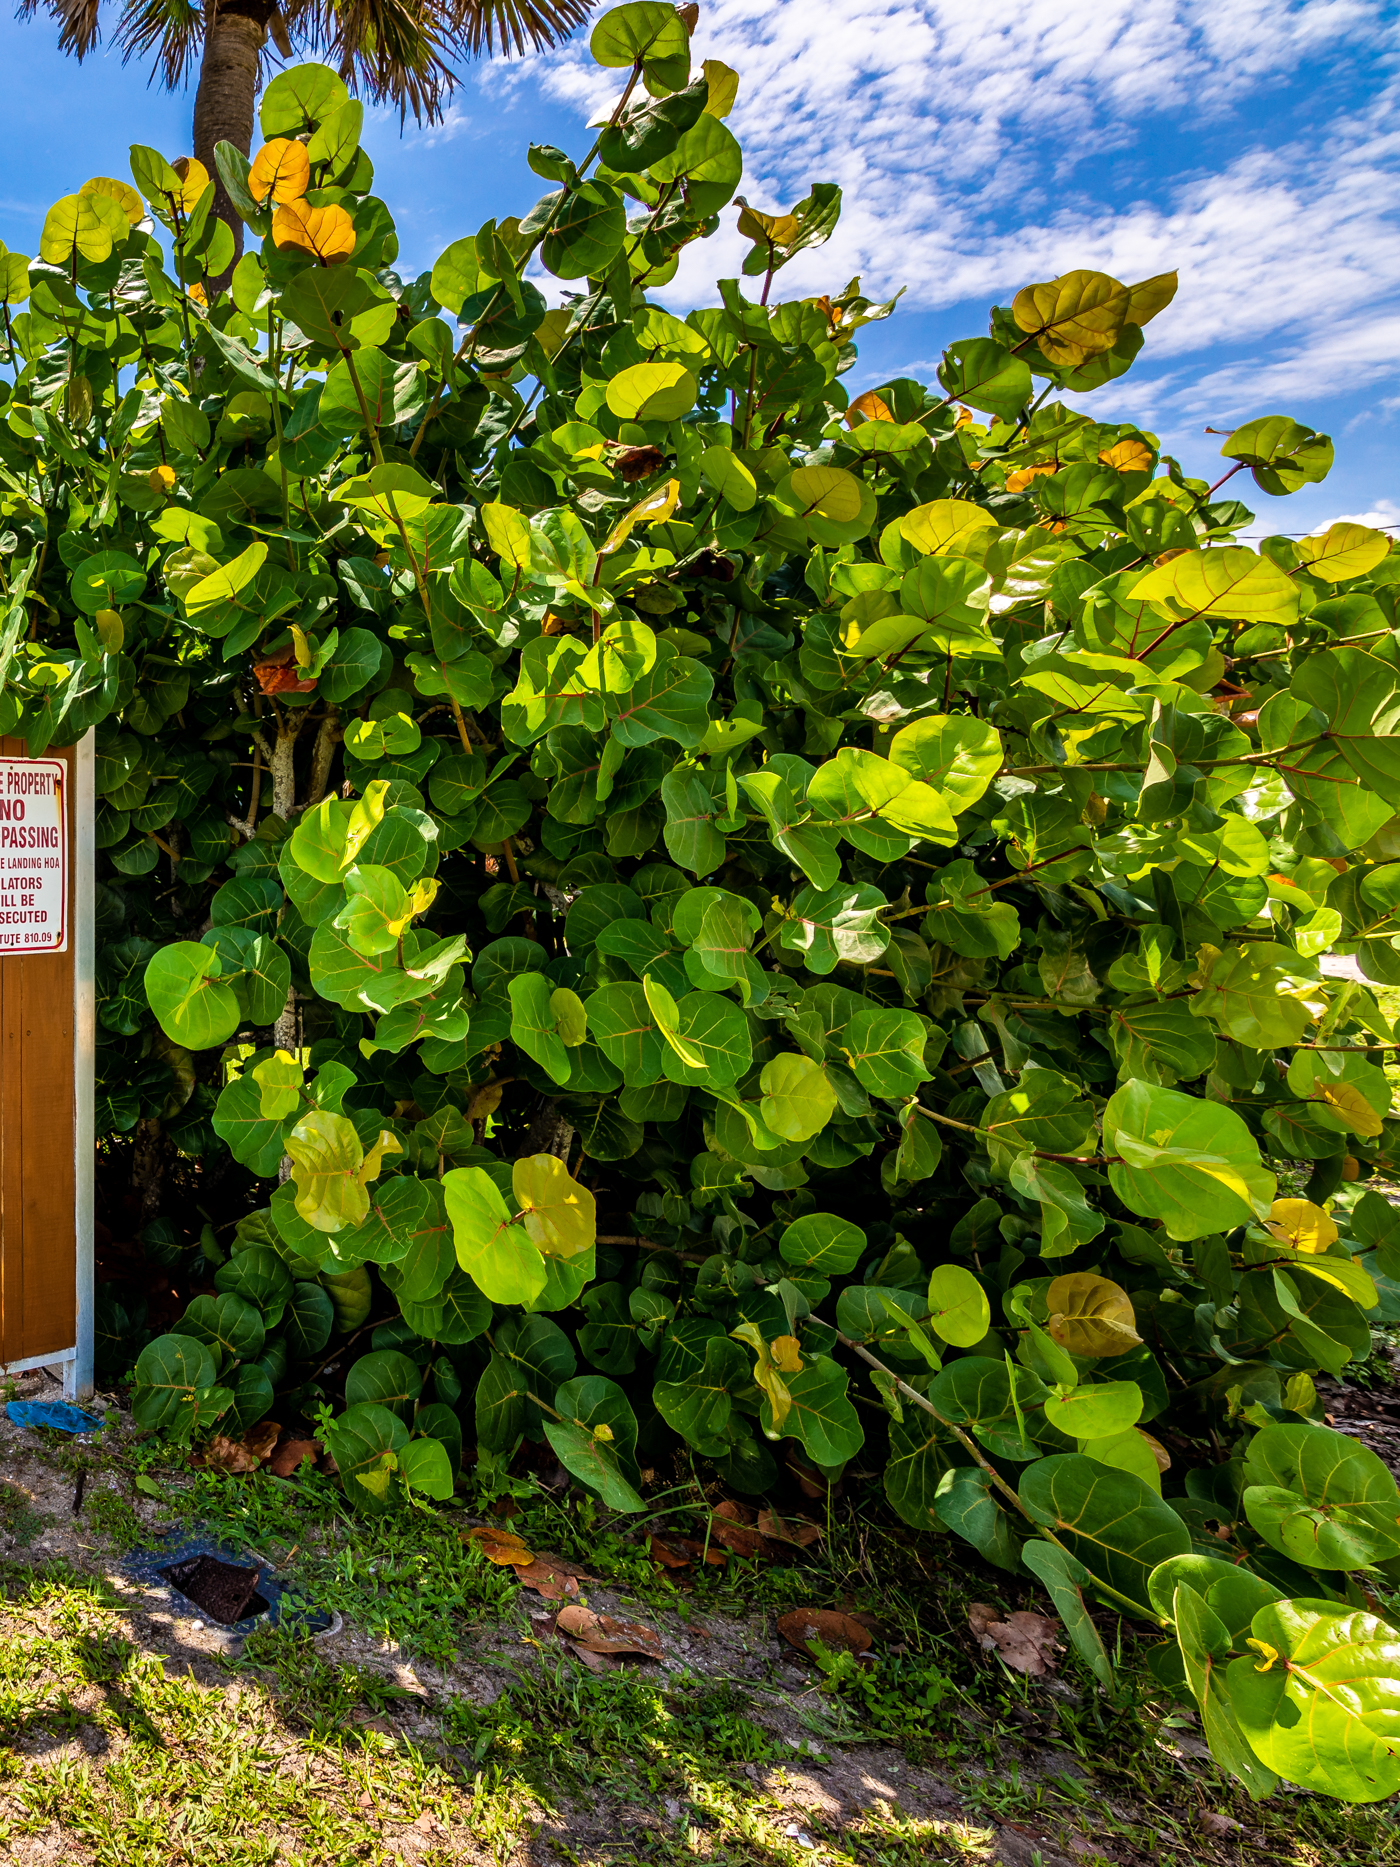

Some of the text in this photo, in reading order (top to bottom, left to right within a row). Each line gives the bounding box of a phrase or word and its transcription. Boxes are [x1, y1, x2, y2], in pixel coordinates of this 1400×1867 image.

[7, 771, 58, 796] PROPERTY
[0, 798, 26, 822] NO
[7, 857, 42, 870] LANDING
[44, 857, 60, 869] HOA
[20, 893, 35, 907] BE
[24, 932, 52, 944] 810.09
